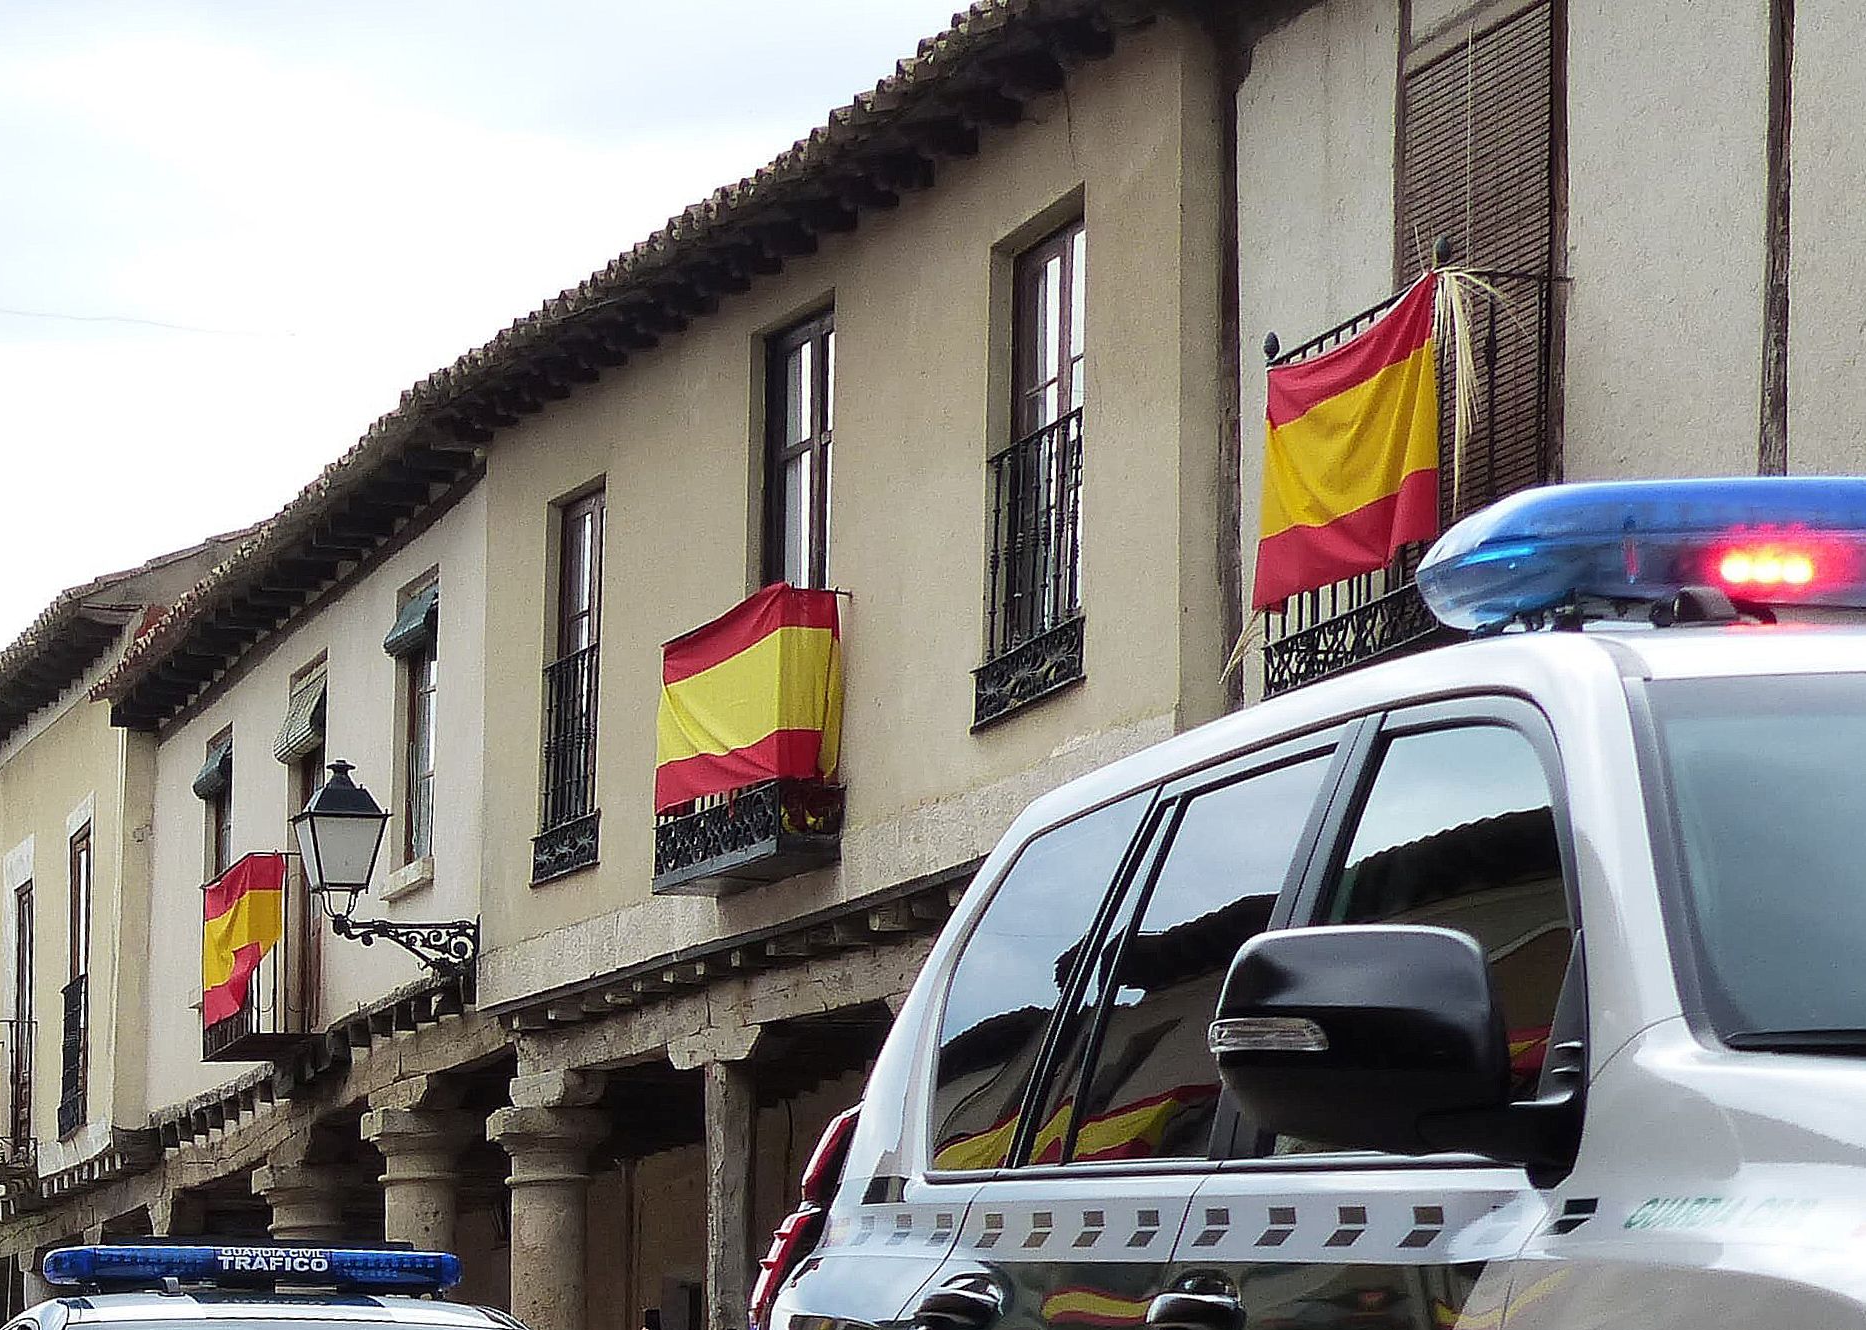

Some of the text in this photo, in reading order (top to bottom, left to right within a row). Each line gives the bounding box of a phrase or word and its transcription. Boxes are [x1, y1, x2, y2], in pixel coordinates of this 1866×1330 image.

[221, 1247, 326, 1257] GUARDIA CIVIL
[217, 1255, 329, 1272] TRAFICO
